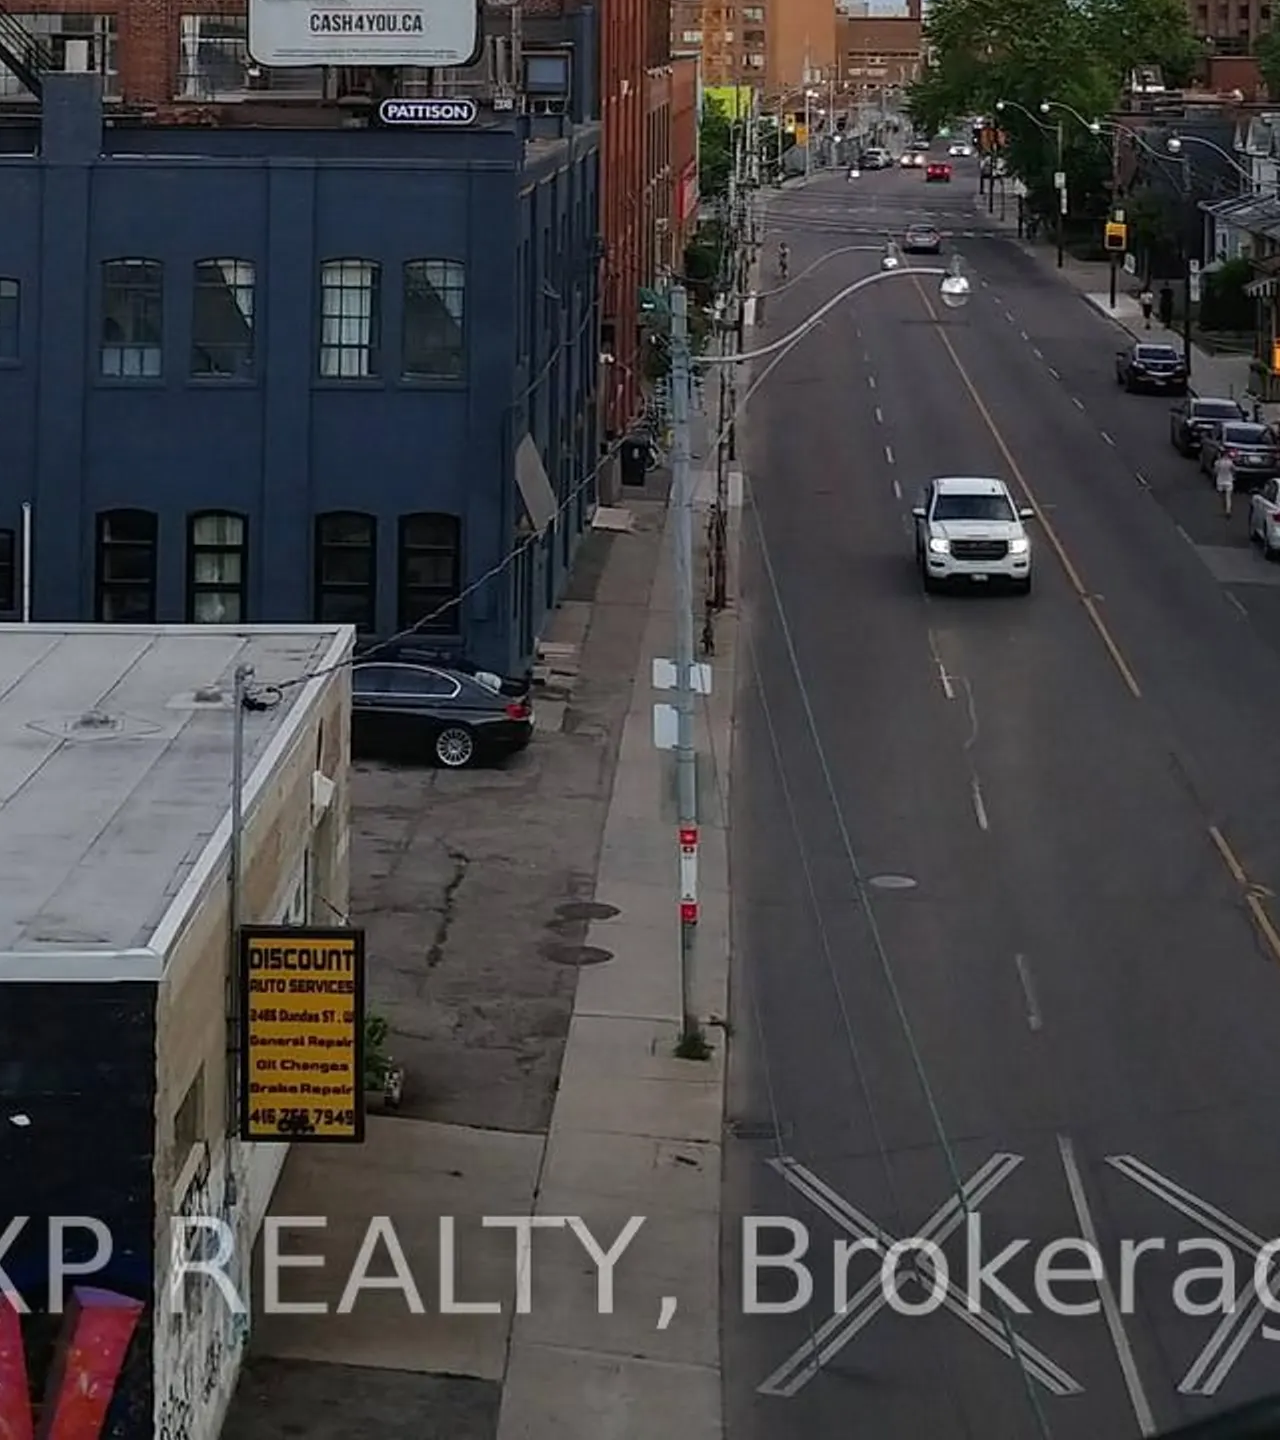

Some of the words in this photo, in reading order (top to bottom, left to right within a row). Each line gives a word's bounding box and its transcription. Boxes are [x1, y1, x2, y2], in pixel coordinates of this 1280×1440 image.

[309, 13, 424, 33] CASH4YOU.CA
[387, 104, 469, 120] PATTISON
[250, 948, 355, 971] DISCOUNT
[250, 978, 286, 993] AUTO
[289, 978, 355, 994] SERVICES
[279, 1008, 320, 1023] Dundas
[250, 1035, 305, 1047] General
[308, 1036, 353, 1049] Repair
[280, 1059, 349, 1074] Changes
[250, 1082, 298, 1093] Brake
[300, 1083, 353, 1096] Repair
[250, 1108, 276, 1125] 416
[314, 1109, 354, 1126] 7949
